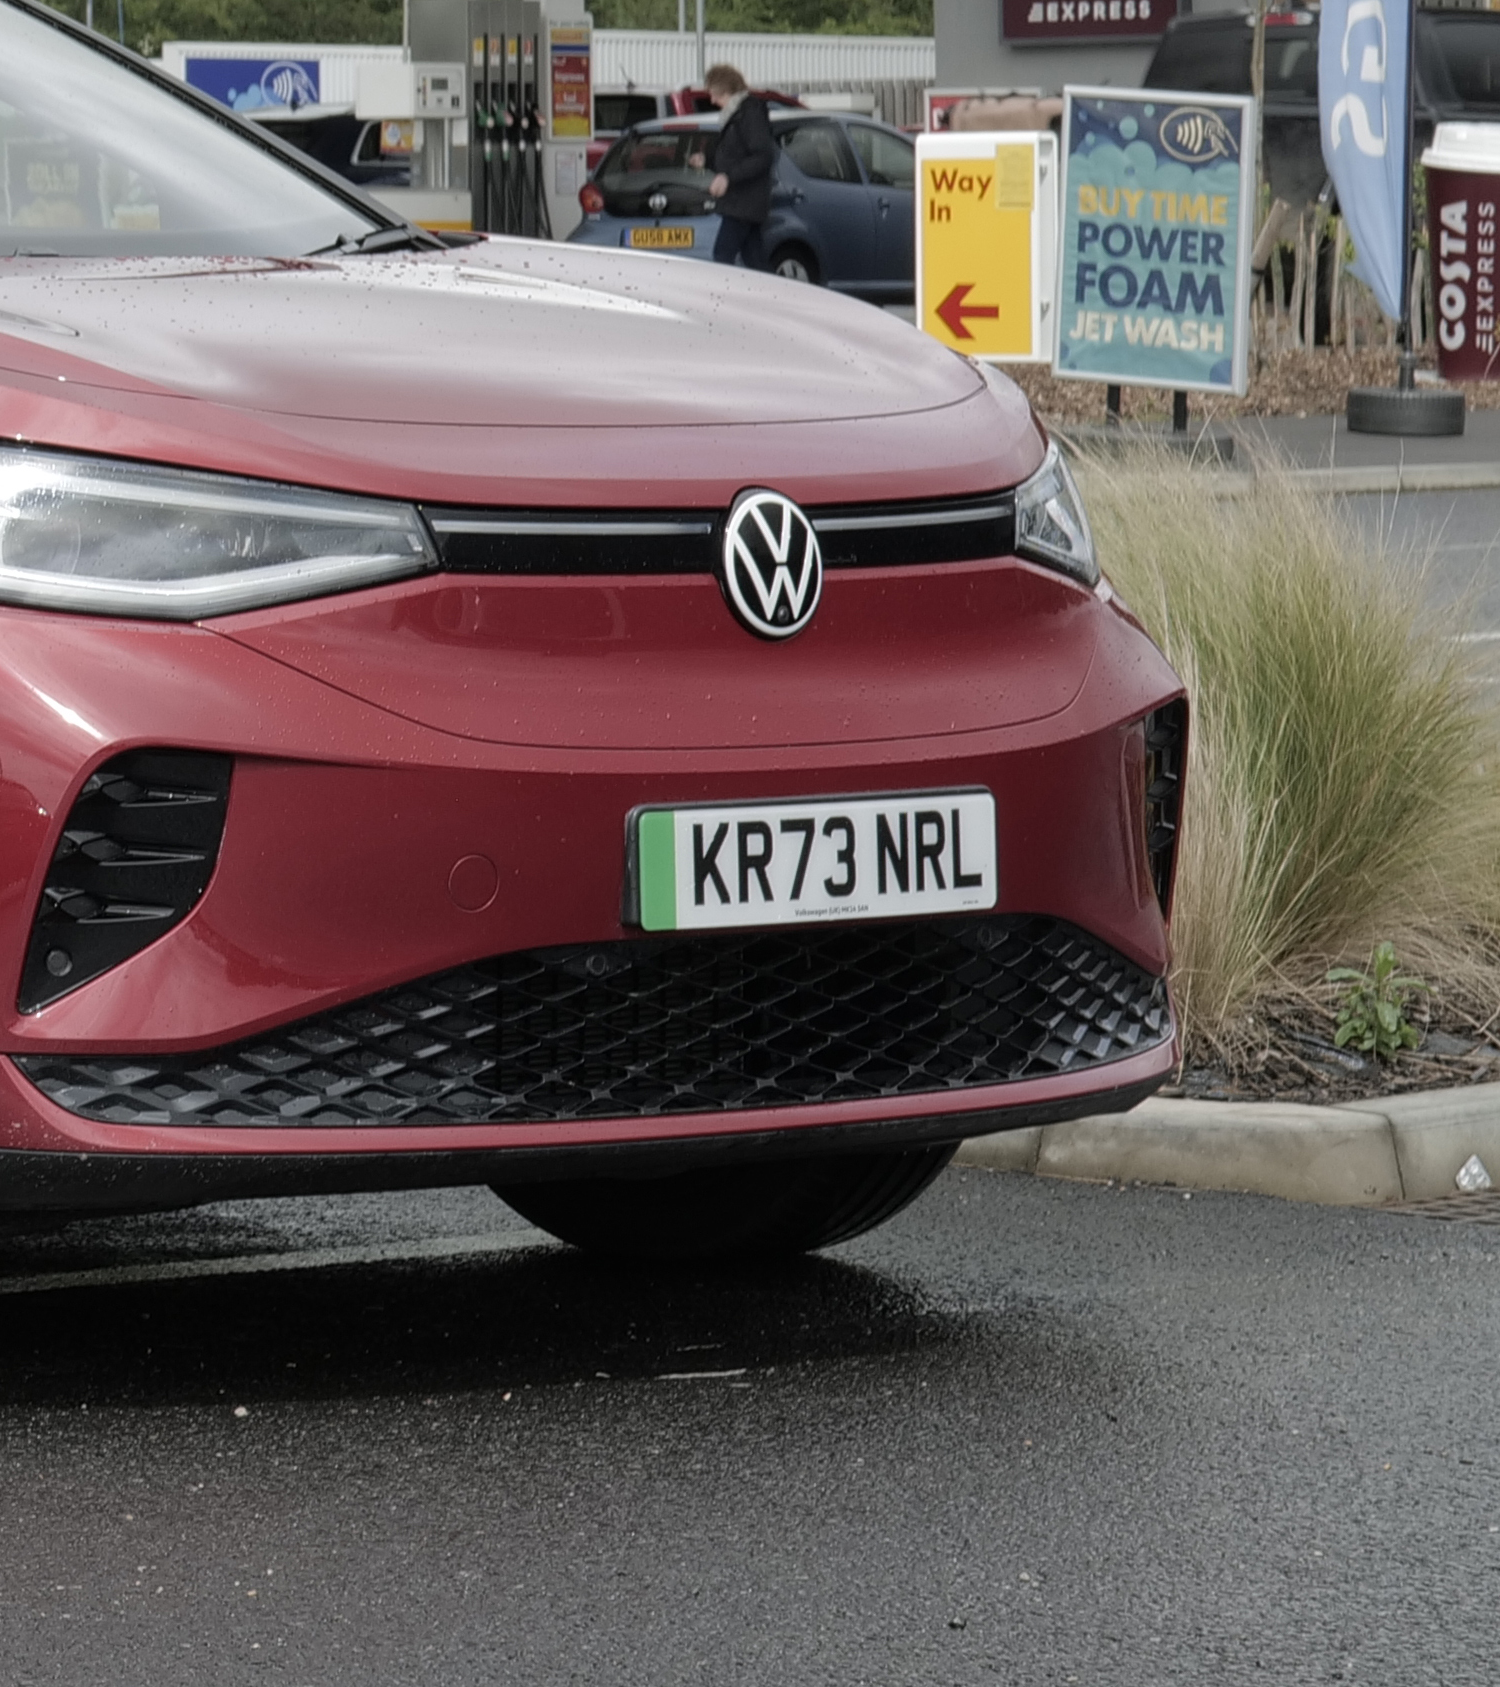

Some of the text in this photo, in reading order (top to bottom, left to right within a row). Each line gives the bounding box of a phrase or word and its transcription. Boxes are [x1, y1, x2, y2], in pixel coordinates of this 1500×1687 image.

[1047, 0, 1151, 23] EXPRESS
[930, 168, 993, 200] Way
[1077, 184, 1229, 226] BUY TIME
[930, 199, 952, 224] In
[1076, 221, 1226, 267] POWER
[1476, 201, 1496, 332] EXPRESS
[1074, 264, 1225, 317] FOAM
[1439, 200, 1471, 352] COSTA
[1069, 310, 1225, 354] JET WASH
[693, 809, 983, 906] KR73 NRL
